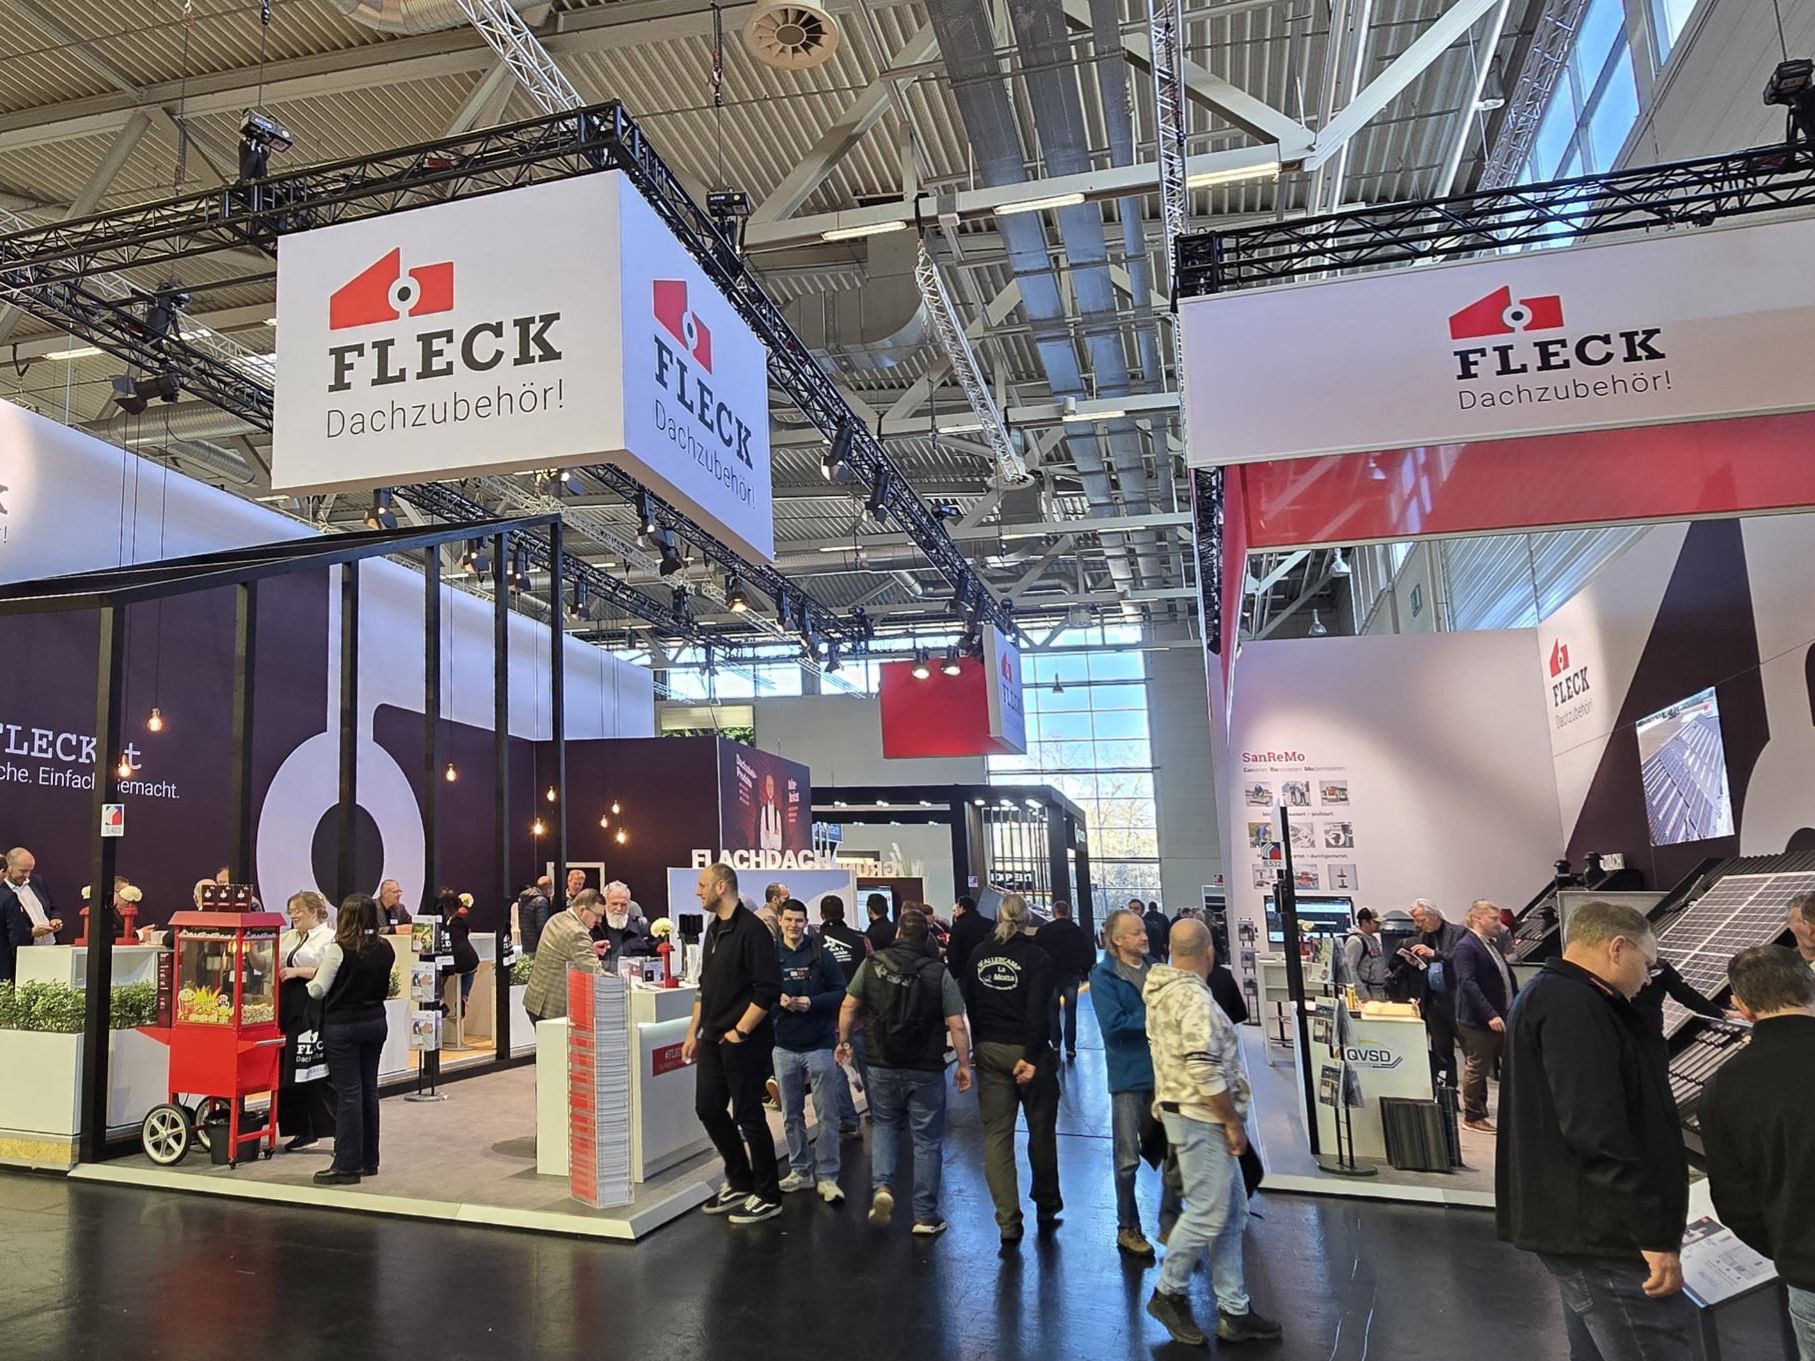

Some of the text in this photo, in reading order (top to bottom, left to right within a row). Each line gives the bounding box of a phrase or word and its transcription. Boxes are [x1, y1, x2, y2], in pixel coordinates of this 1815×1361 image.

[328, 312, 562, 393] FLECK
[1453, 328, 1666, 380] FLECK
[327, 378, 563, 438] Dachzubehör!
[654, 334, 753, 470] FLECK
[1459, 370, 1672, 410] Dachzubehör!
[655, 399, 755, 510] Dachzubehör!
[1552, 666, 1590, 707] FLECK
[1242, 752, 1306, 763] SanReMo
[1347, 1049, 1391, 1063] QVSD
